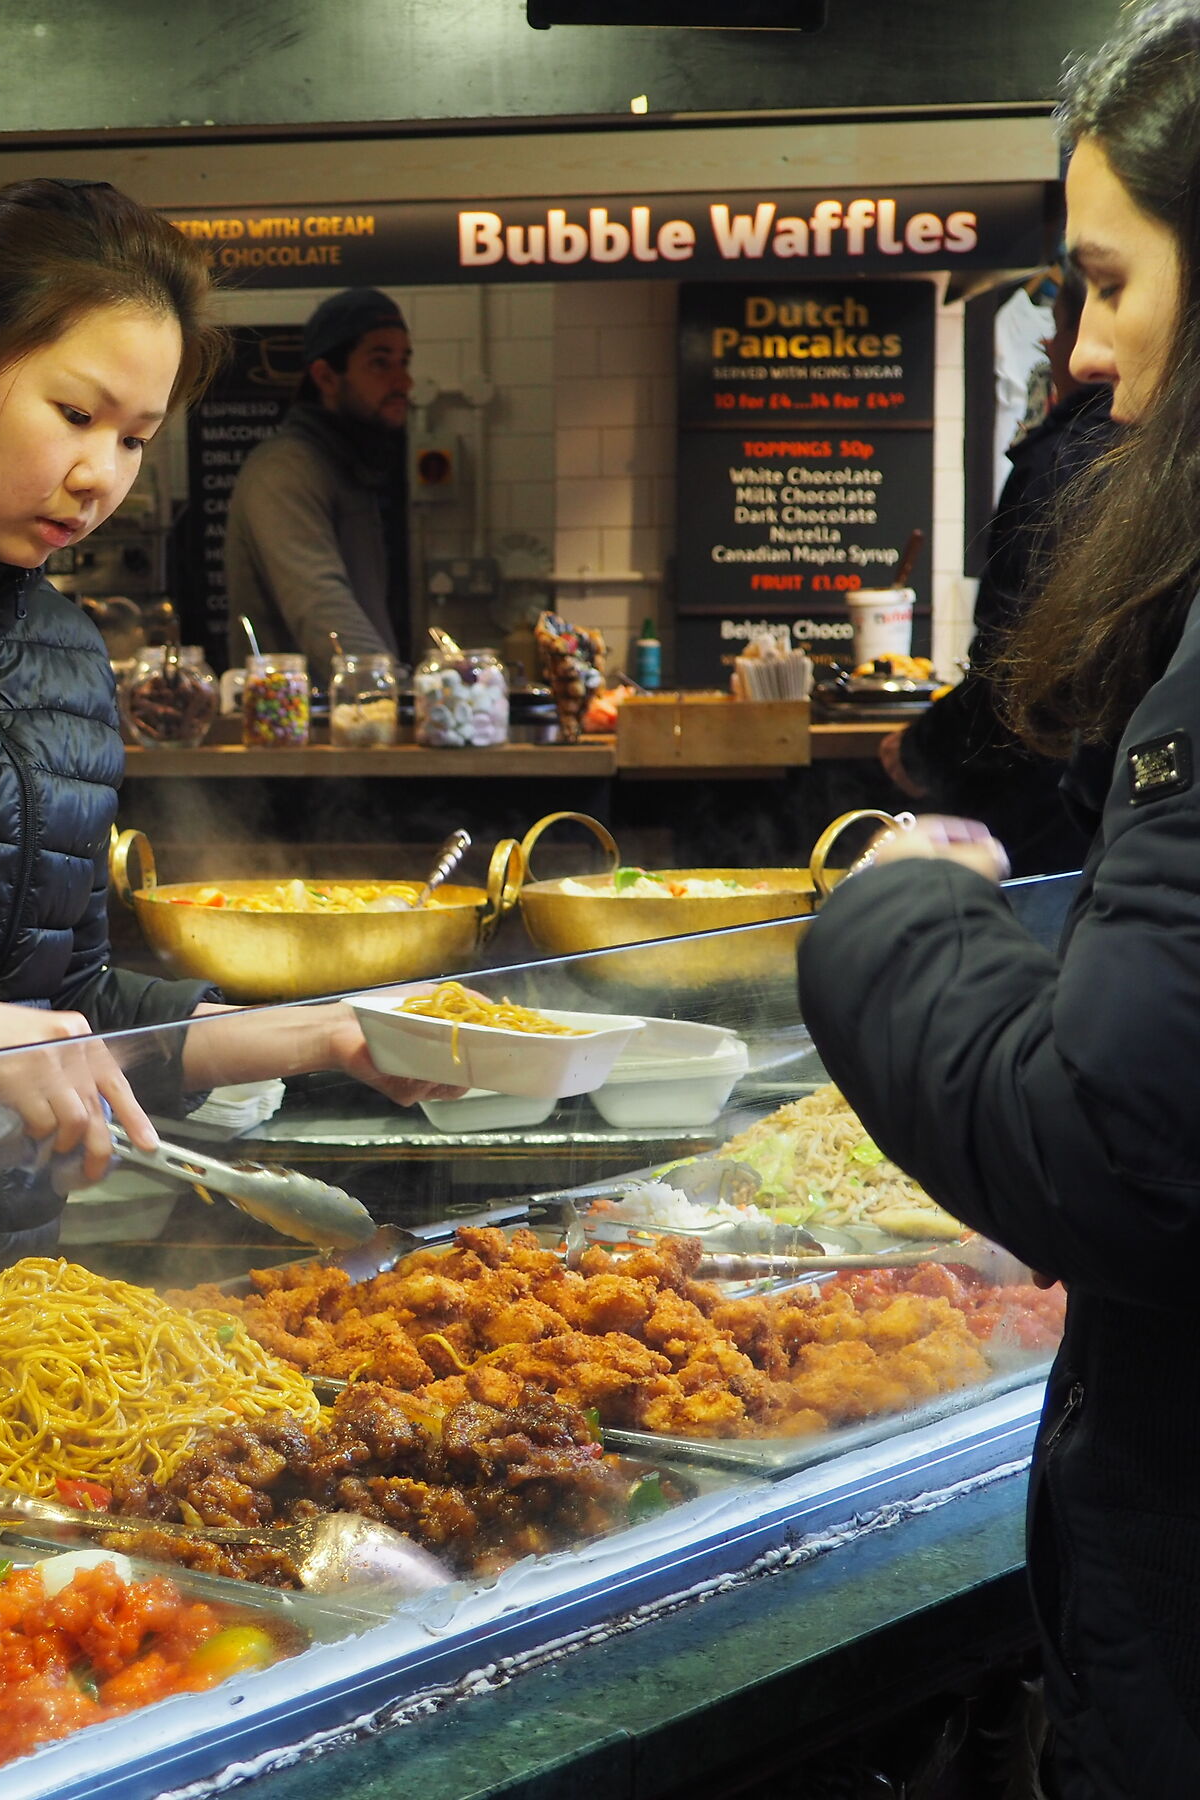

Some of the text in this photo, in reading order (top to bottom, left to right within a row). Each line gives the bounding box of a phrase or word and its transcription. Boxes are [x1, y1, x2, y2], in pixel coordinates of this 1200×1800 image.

[173, 215, 375, 239] ERVED WITH CREAM
[458, 199, 978, 267] Bubble Waffles
[220, 246, 343, 268] CHOCOLATE
[744, 296, 869, 328] Dutch
[712, 326, 903, 359] Pancakes
[770, 365, 808, 379] WITH
[810, 365, 851, 379] ICING
[853, 364, 904, 379] SUGAR
[714, 393, 736, 409] 10
[738, 393, 765, 409] for
[833, 392, 860, 409] for
[743, 440, 875, 460] TOPPINGS 50p
[729, 466, 883, 485] White Chocolate
[735, 486, 877, 504] Milk Chocolate
[734, 506, 878, 524] Dark Chocolate
[769, 526, 842, 543] Nutella
[711, 544, 900, 567] Canadian Maple Syrup
[751, 574, 863, 591] FRUIT £1.00
